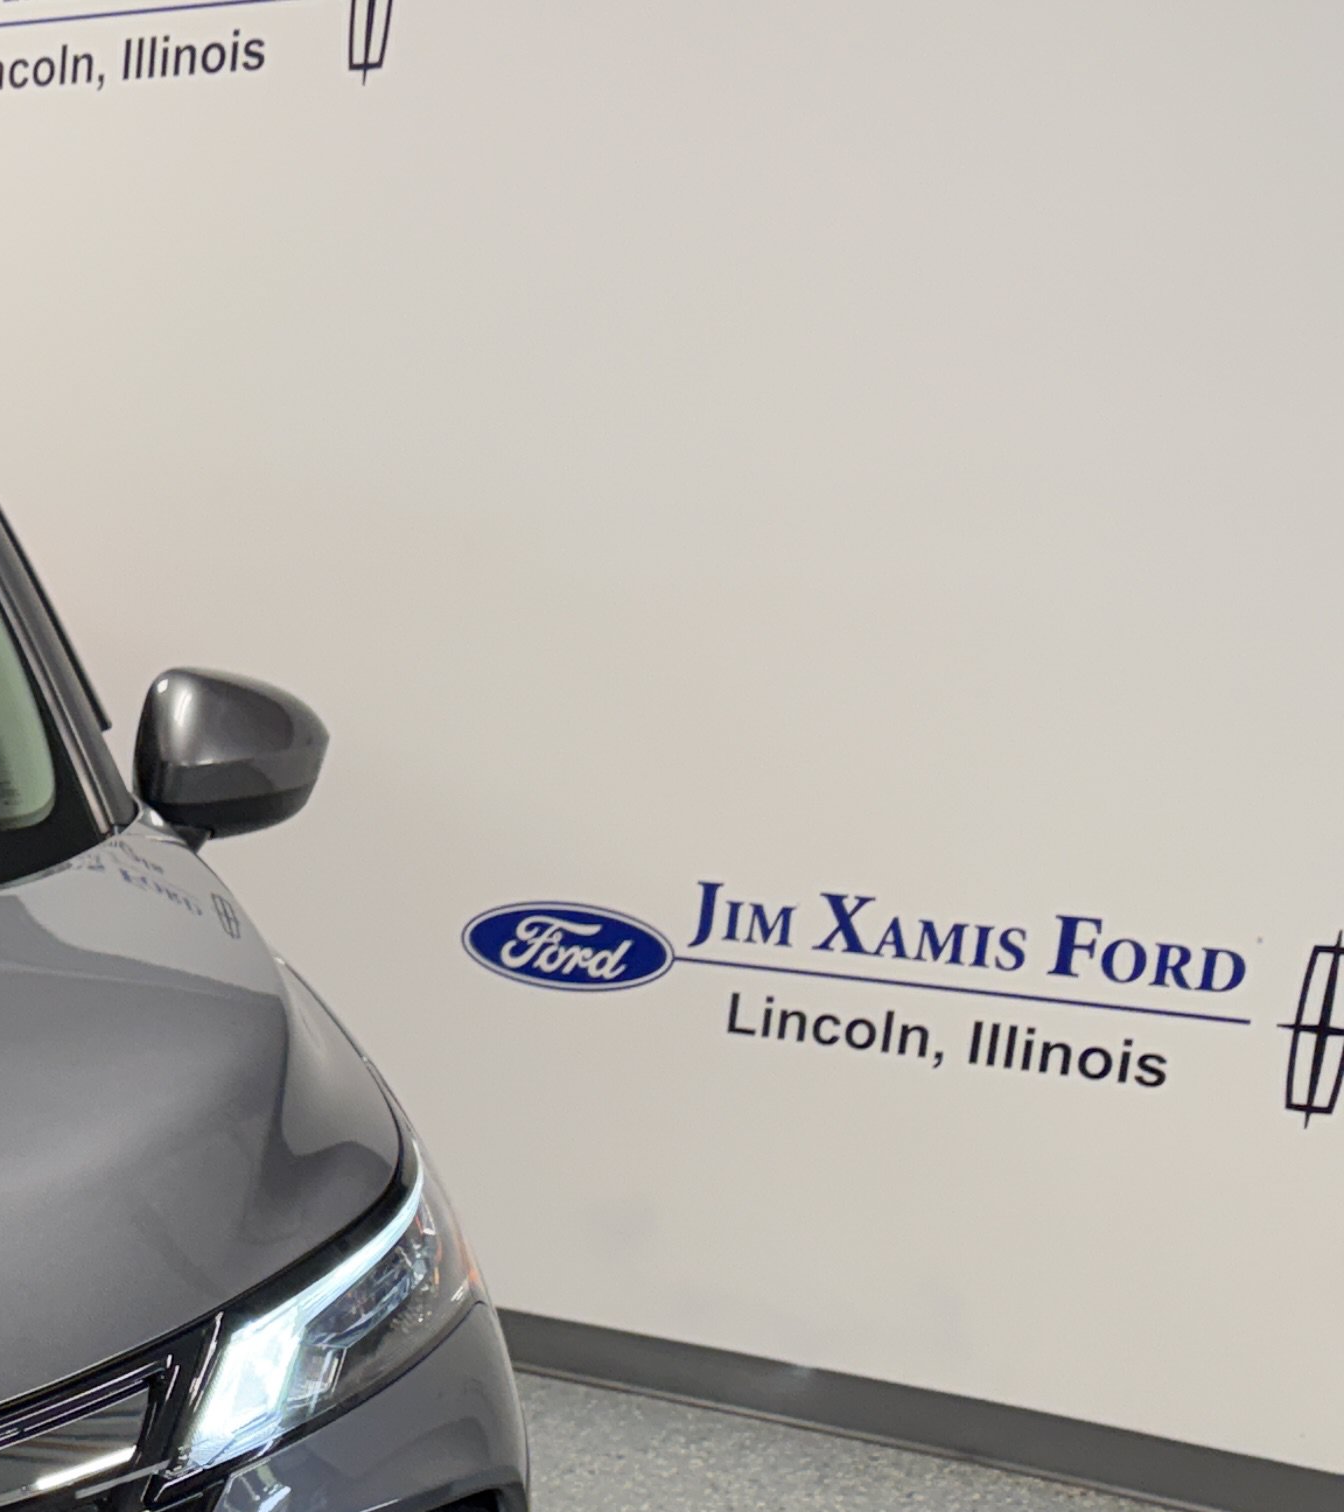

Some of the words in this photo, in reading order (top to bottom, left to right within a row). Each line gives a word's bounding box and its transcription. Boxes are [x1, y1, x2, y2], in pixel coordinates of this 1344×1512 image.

[122, 29, 265, 80] Illinois
[500, 914, 631, 983] Ford
[687, 881, 795, 948] JIM
[815, 892, 1027, 972] XAMIS
[1047, 914, 1246, 994] FORD
[726, 992, 945, 1069] Lincoln,
[968, 1021, 1168, 1088] Illinois
